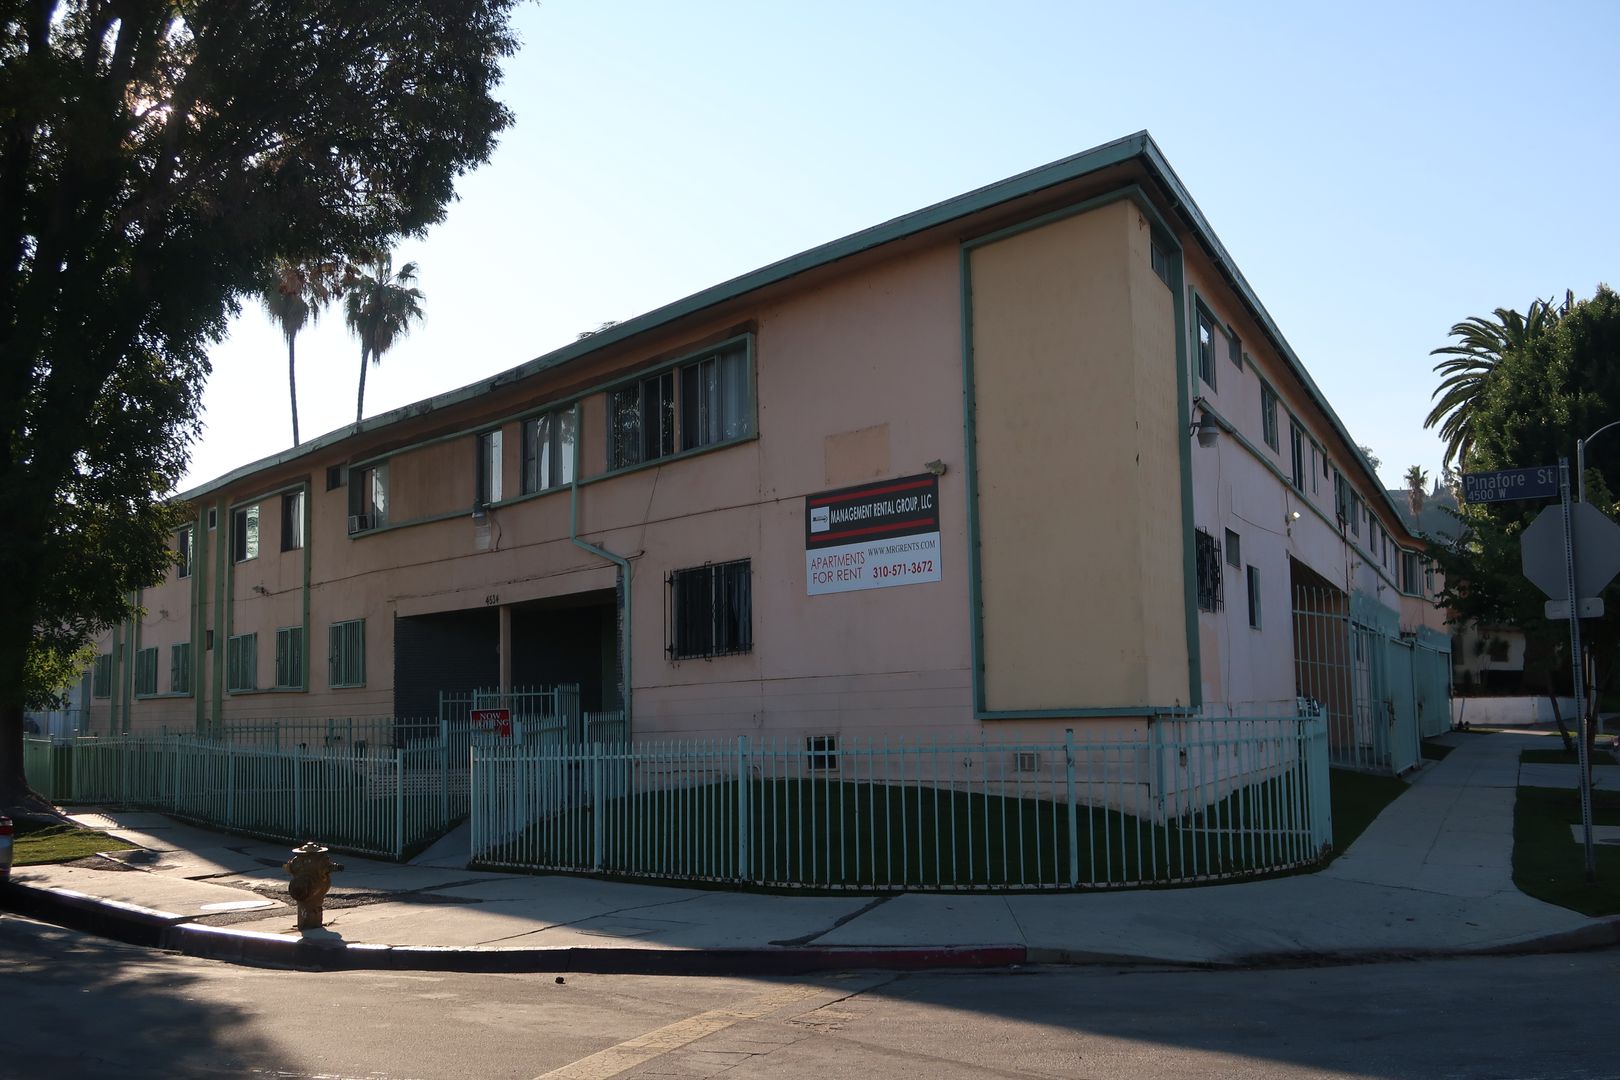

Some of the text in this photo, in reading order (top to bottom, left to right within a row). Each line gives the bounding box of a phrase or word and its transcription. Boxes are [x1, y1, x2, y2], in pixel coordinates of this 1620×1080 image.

[1466, 469, 1553, 490] Pinafore St
[1468, 488, 1506, 501] 4500 W
[830, 494, 932, 524] MANAGEMENT RENTAL GROUP, LLC
[867, 540, 936, 557] WWW.MRGRENTS.COM
[810, 551, 865, 570] APARTMENTS
[872, 560, 933, 578] 310-571-3672
[812, 567, 863, 584] FOR RENT
[480, 712, 501, 720] NOW
